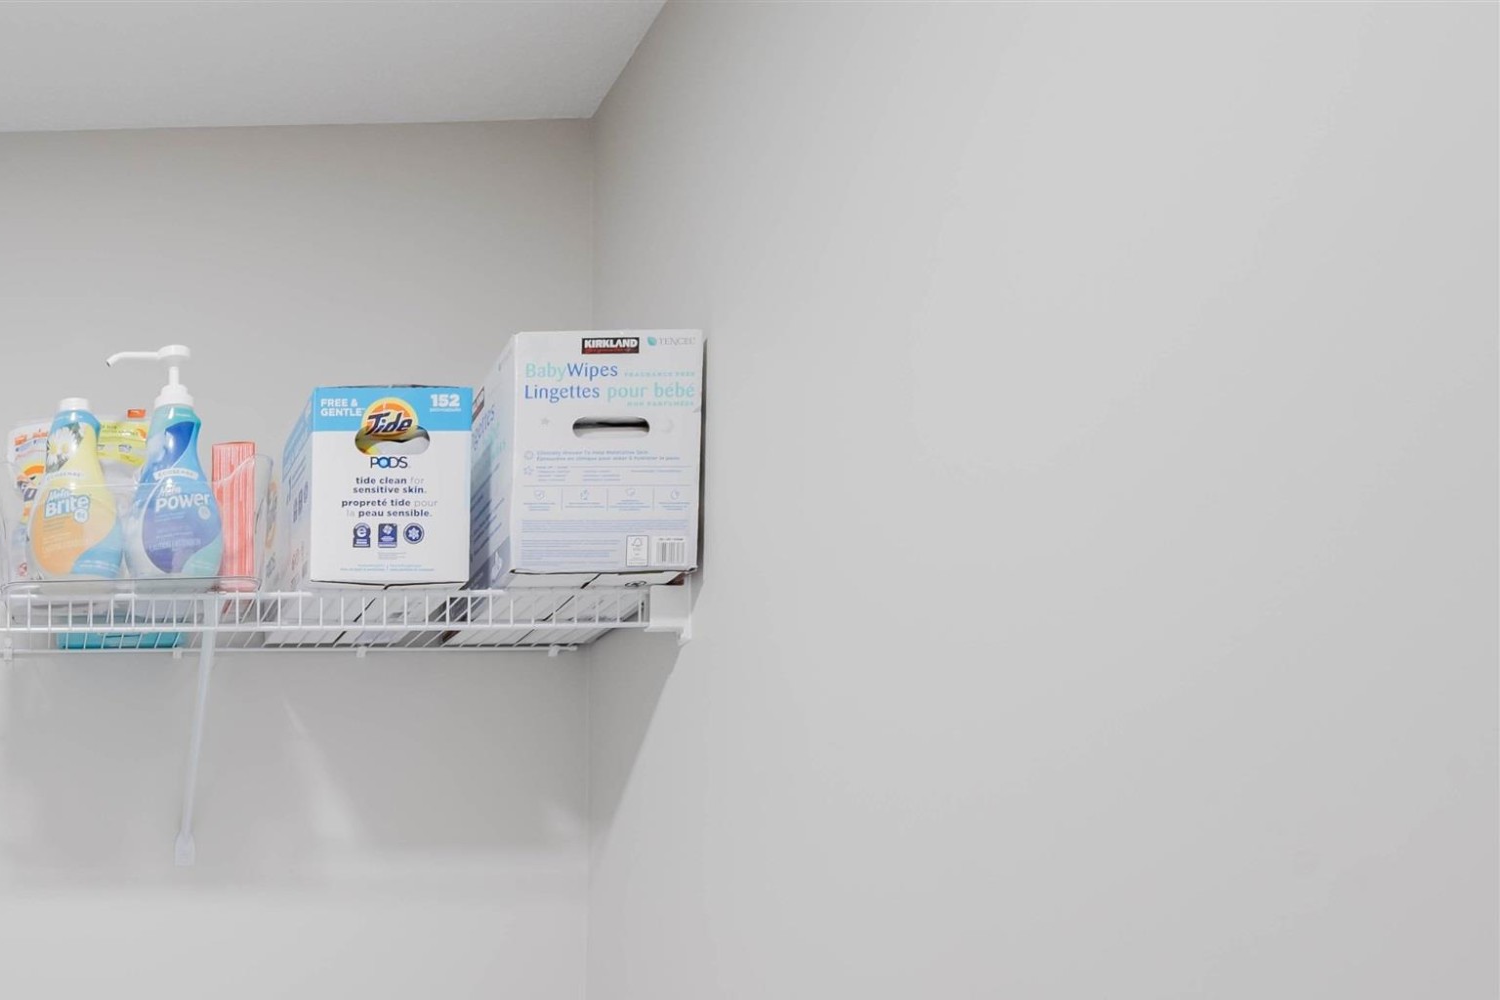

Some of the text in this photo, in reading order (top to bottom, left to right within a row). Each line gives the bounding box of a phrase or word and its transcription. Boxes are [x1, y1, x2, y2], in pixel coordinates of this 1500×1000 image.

[584, 338, 638, 349] KIRKLAND
[524, 382, 696, 403] Lingettes pour bébé
[321, 398, 358, 407] FREE &
[430, 394, 460, 408] 152
[366, 411, 412, 435] Tide
[370, 456, 408, 469] PODS
[410, 476, 424, 484] for
[353, 486, 427, 494] sensitive skin.
[45, 495, 90, 518] Brite
[342, 499, 387, 508] propreté
[414, 500, 438, 508] pour
[358, 510, 384, 518] peau
